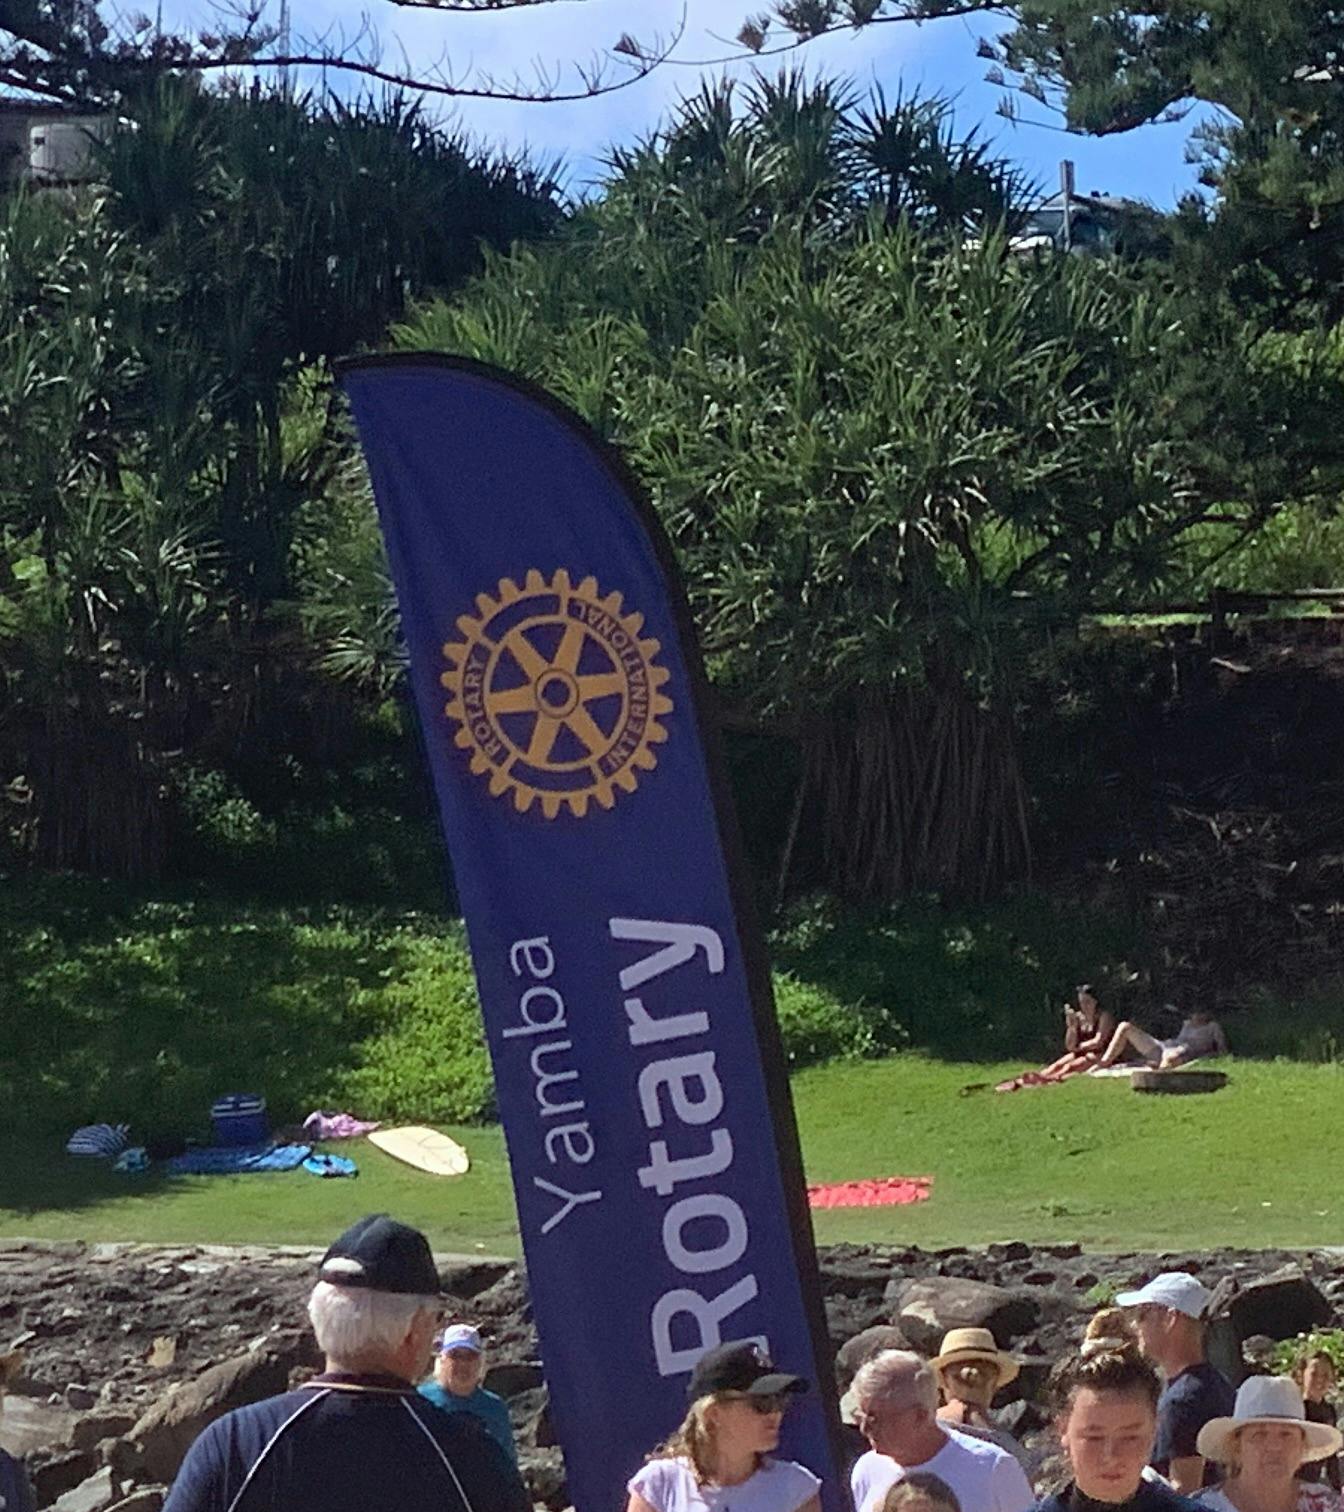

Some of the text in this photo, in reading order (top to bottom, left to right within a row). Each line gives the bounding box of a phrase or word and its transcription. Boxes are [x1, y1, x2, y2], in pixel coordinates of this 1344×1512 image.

[463, 652, 503, 760] ROTARY
[575, 602, 648, 771] INTERNATIONAL
[503, 935, 602, 1235] Yamba
[609, 917, 770, 1377] Rotary
